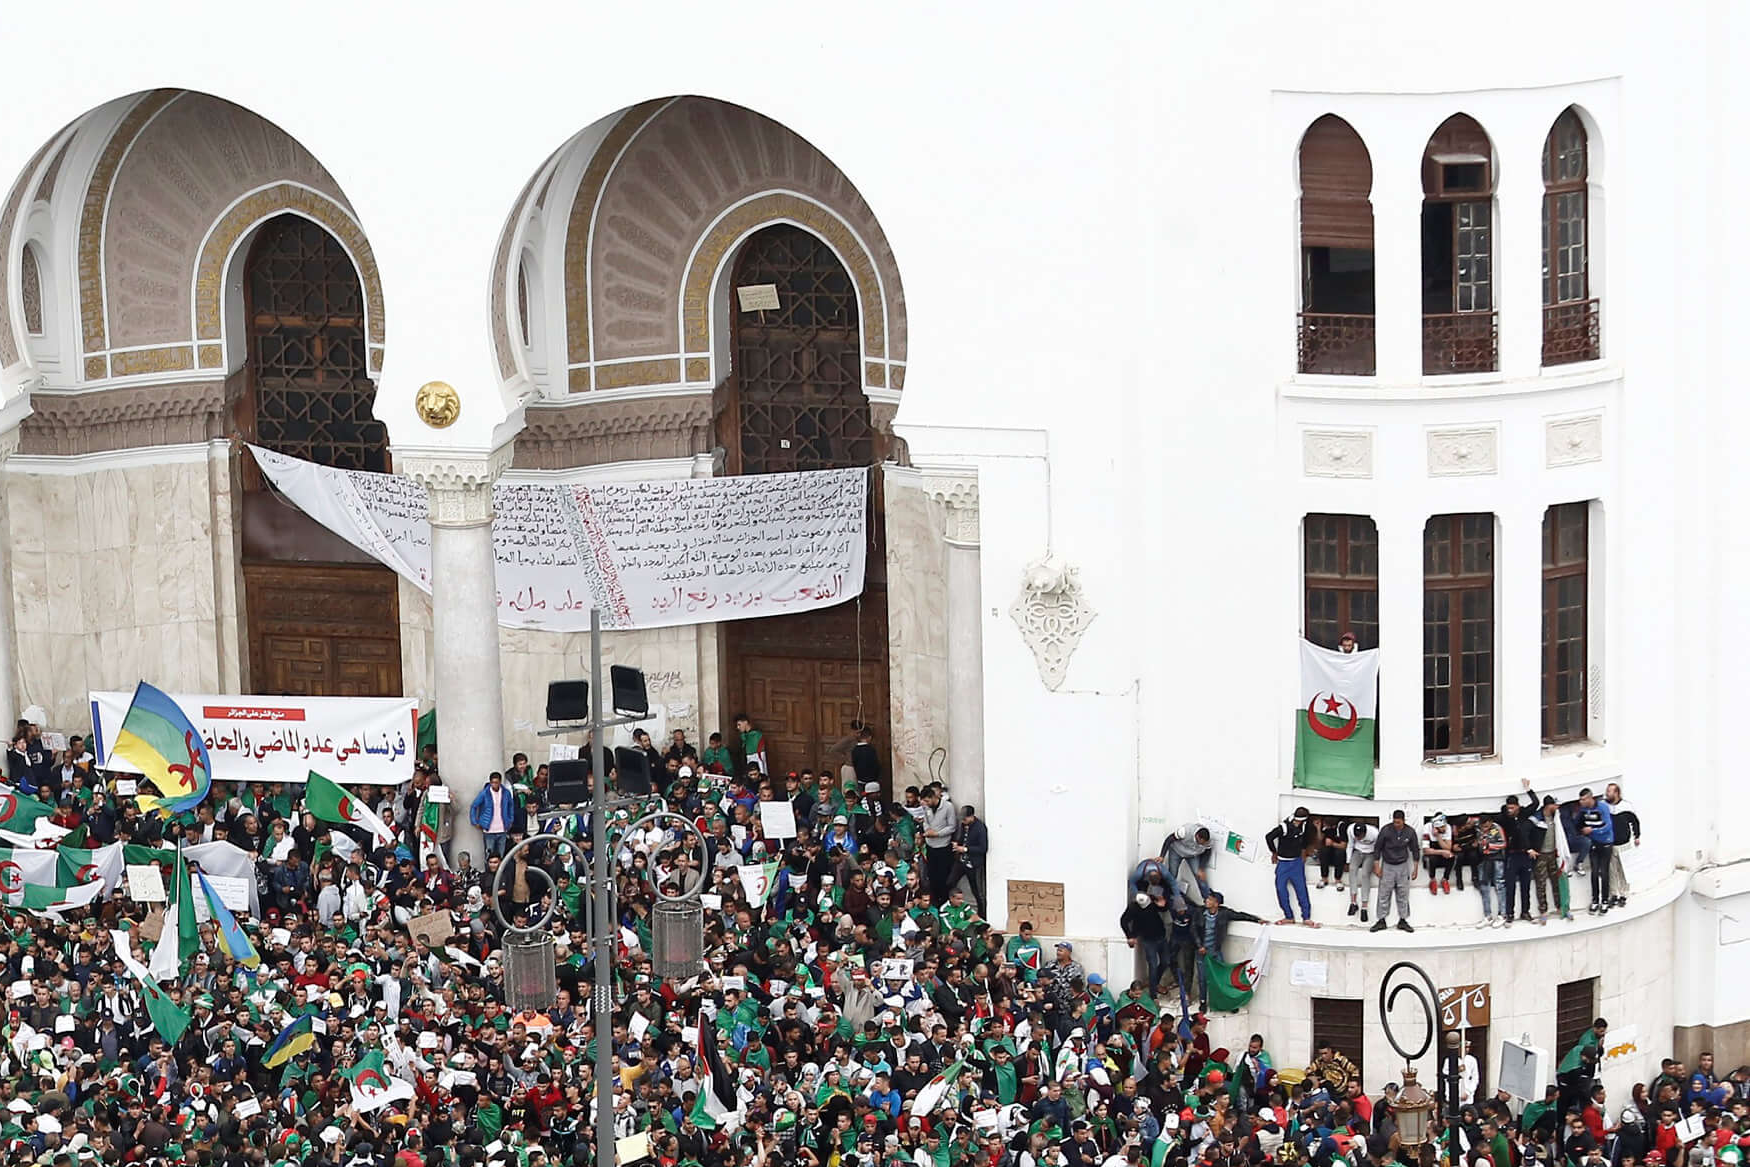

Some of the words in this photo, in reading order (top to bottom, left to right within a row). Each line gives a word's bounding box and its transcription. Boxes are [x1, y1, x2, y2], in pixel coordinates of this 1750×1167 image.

[770, 574, 842, 606] الشعب
[202, 727, 251, 758] والحاض
[254, 727, 300, 764] الماضي
[301, 733, 333, 760] عدو
[337, 737, 361, 766] هي
[363, 727, 406, 762] فرنسا
